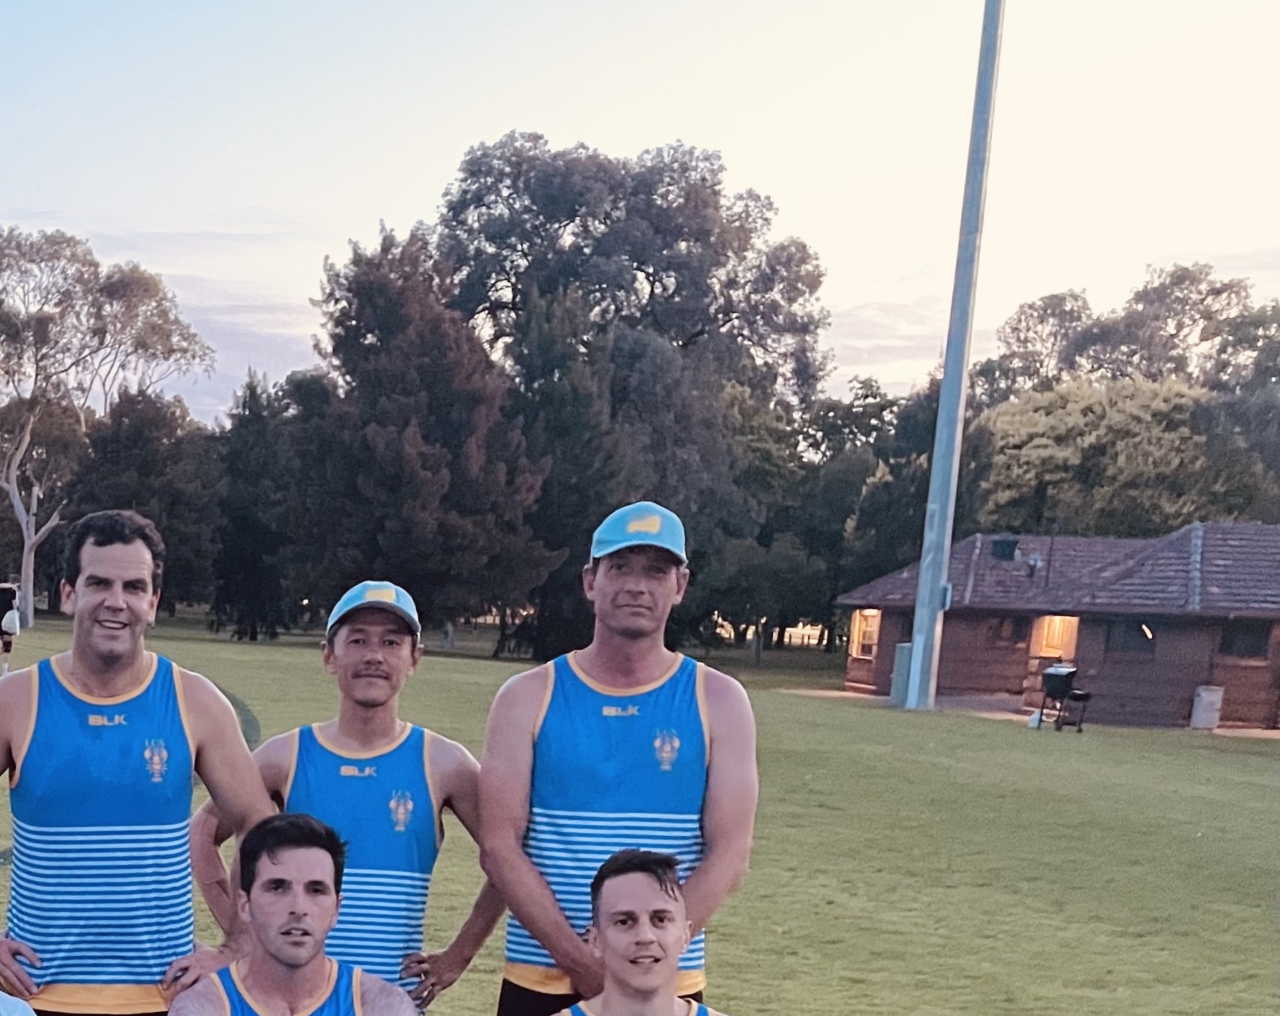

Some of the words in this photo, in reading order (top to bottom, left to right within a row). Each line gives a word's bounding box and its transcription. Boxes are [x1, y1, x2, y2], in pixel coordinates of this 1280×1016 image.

[602, 705, 640, 717] BLK
[88, 714, 127, 726] BLK
[339, 765, 377, 777] BLK
